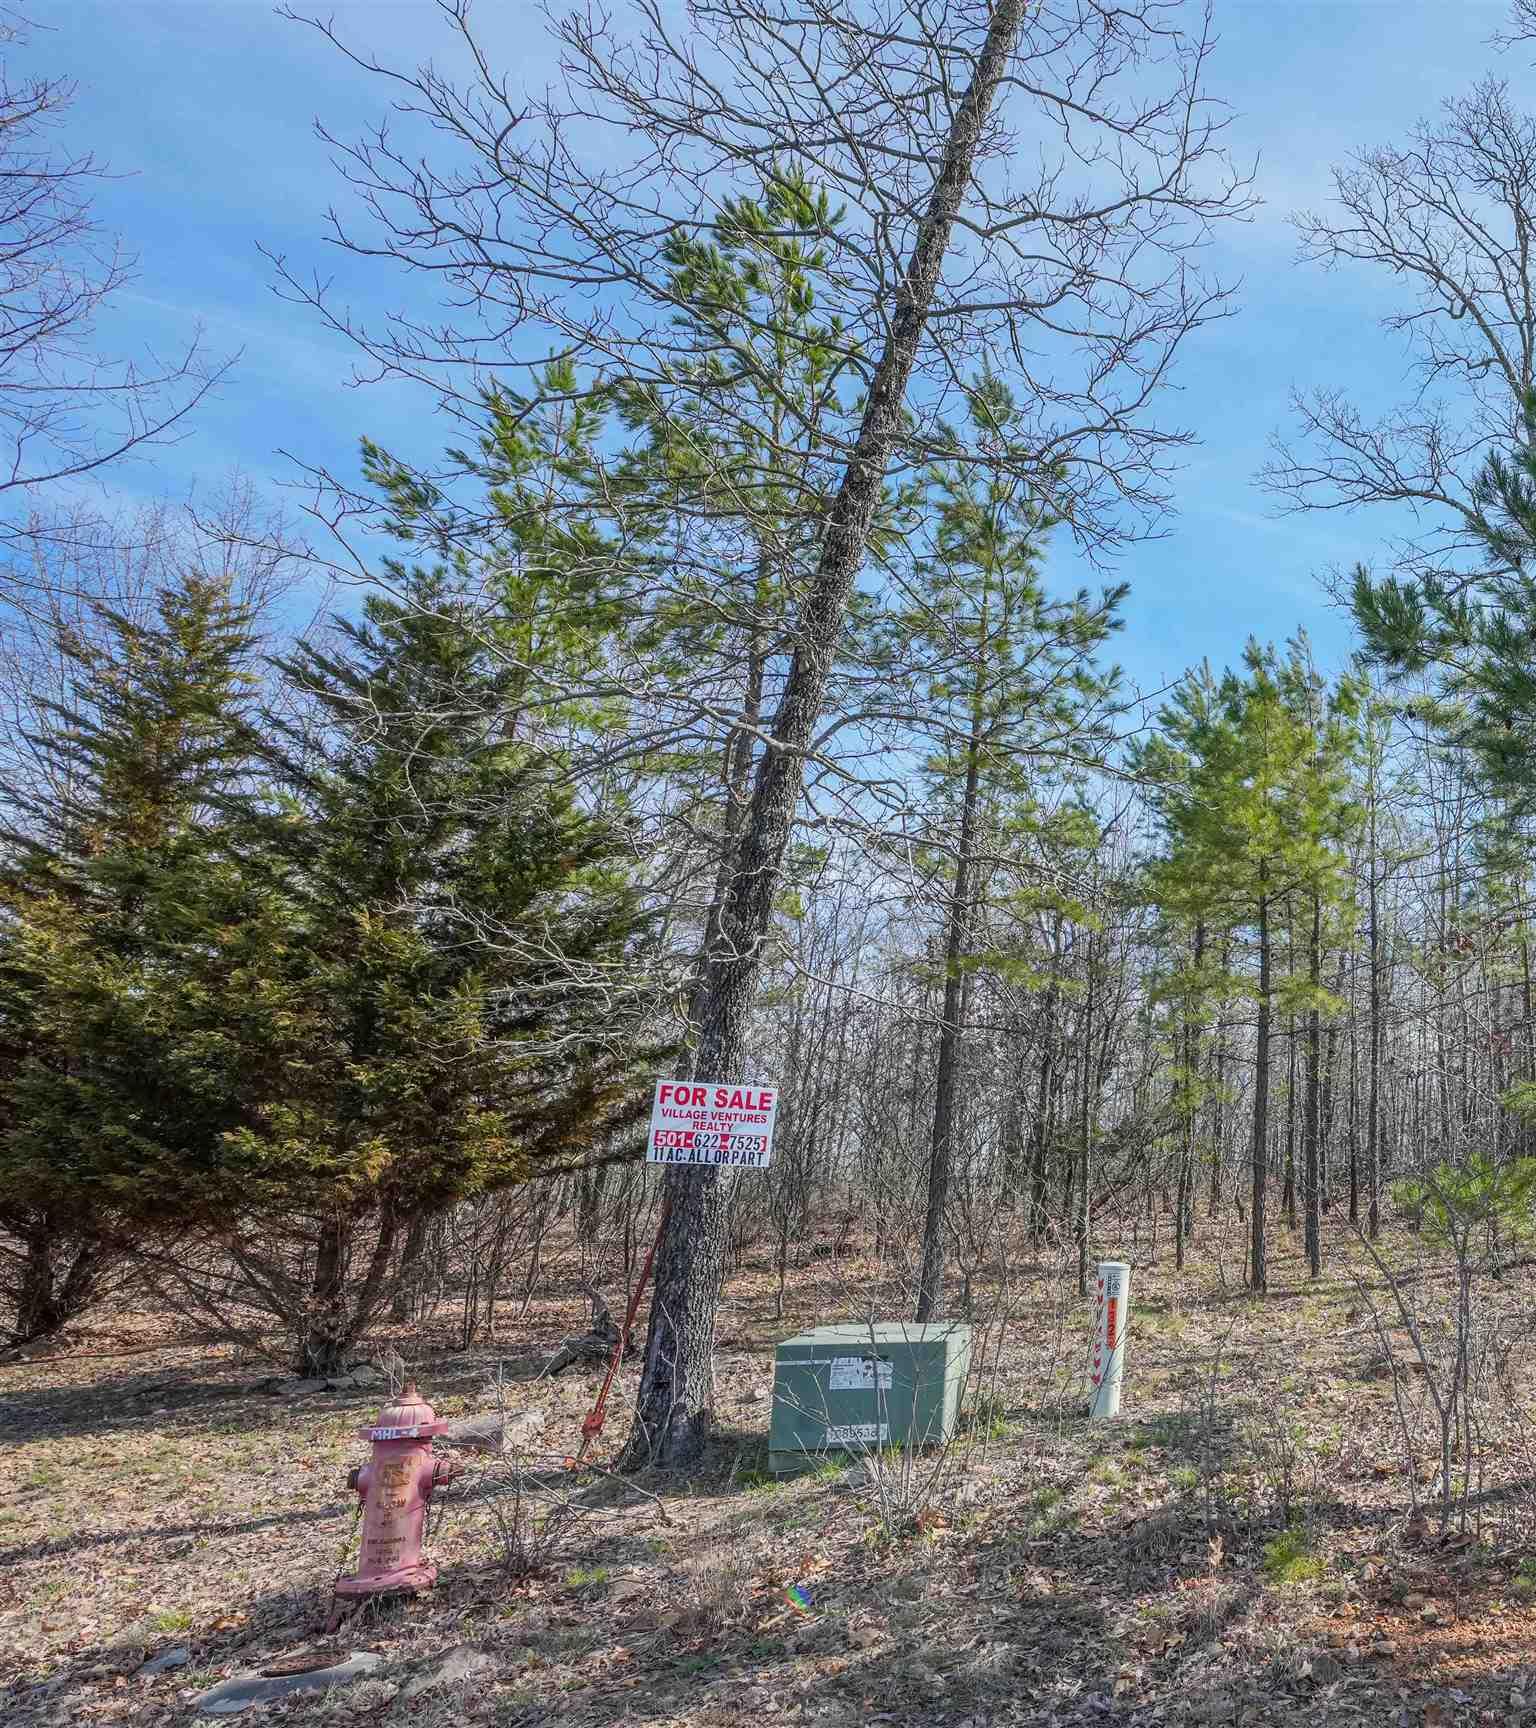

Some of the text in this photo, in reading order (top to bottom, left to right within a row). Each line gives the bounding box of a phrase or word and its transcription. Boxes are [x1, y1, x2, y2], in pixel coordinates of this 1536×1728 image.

[659, 1085, 773, 1111] FOR SALE
[661, 1108, 768, 1124] VILLAGE VENTURES
[692, 1121, 734, 1132] REALTY
[731, 1151, 764, 1166] PART
